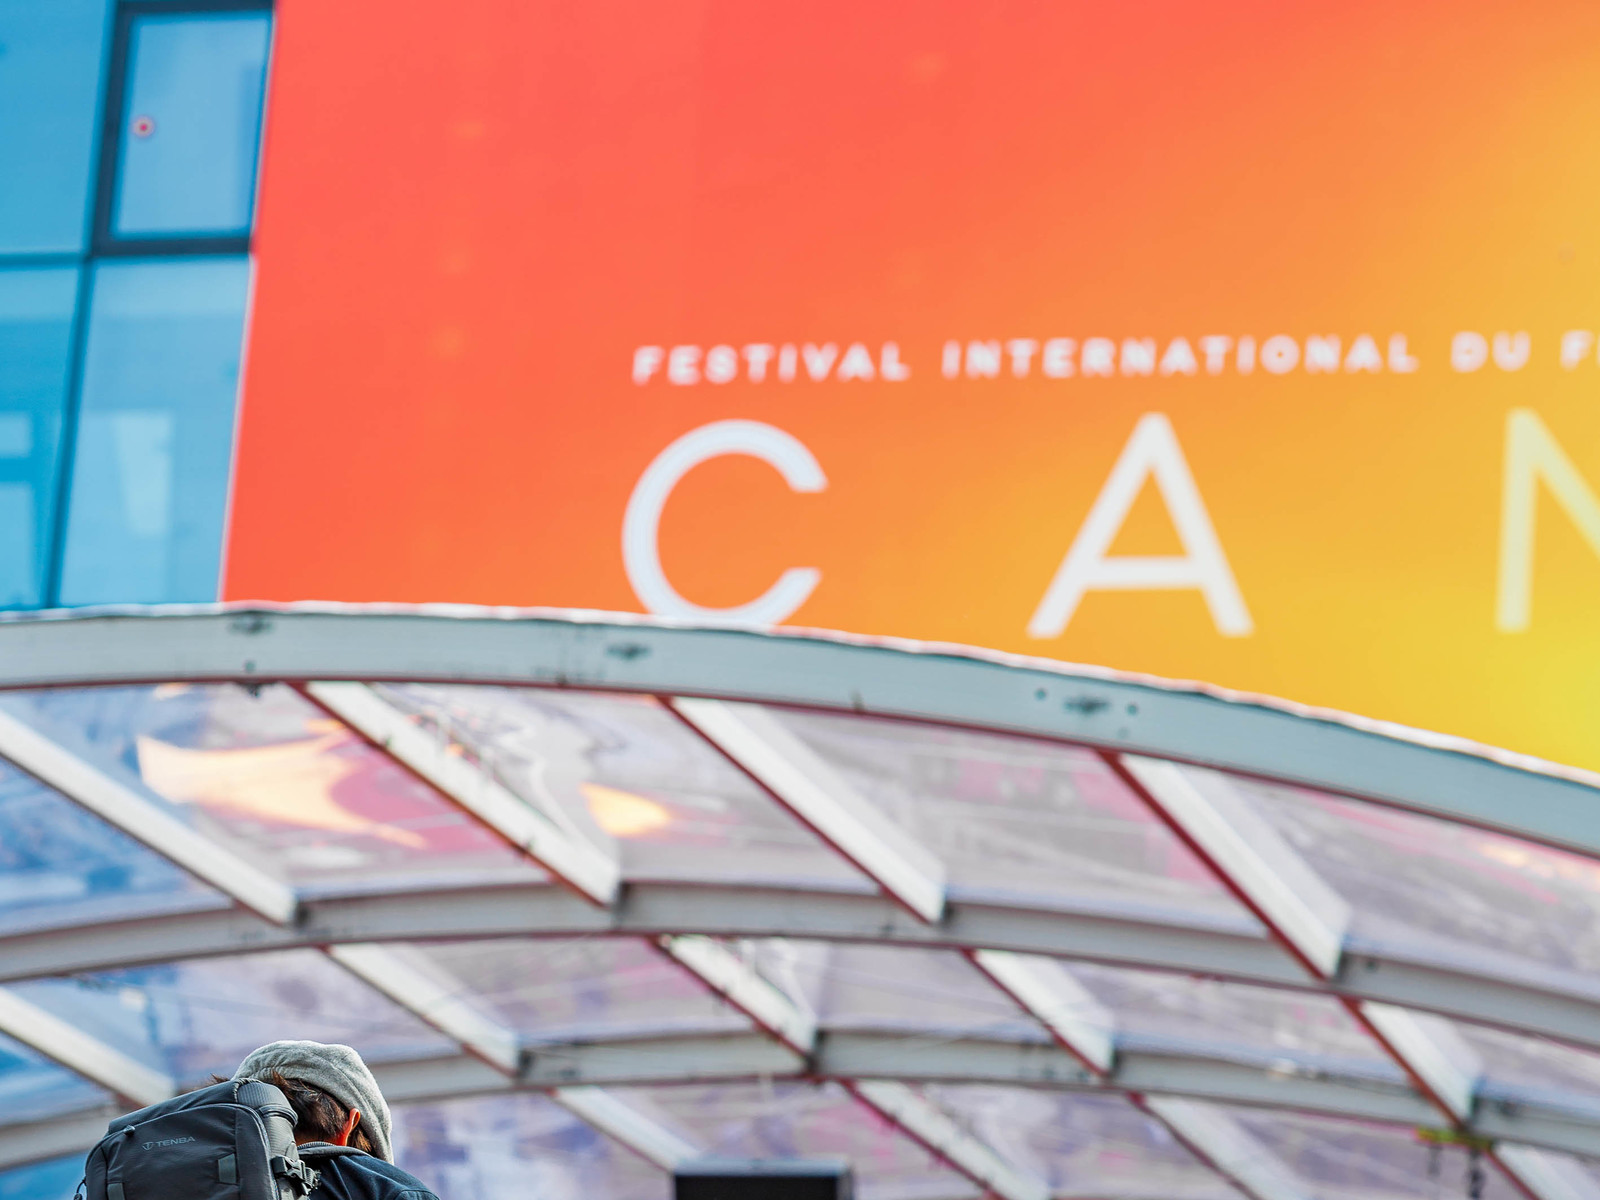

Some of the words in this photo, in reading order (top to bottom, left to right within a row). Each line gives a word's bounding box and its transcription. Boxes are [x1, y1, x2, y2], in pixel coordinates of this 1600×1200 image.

[632, 340, 911, 386] FESTIVAL
[942, 333, 1421, 380] INTERNATIONAL
[1451, 330, 1531, 374] DU
[1559, 329, 1600, 373] F
[155, 1135, 196, 1148] TENBA
